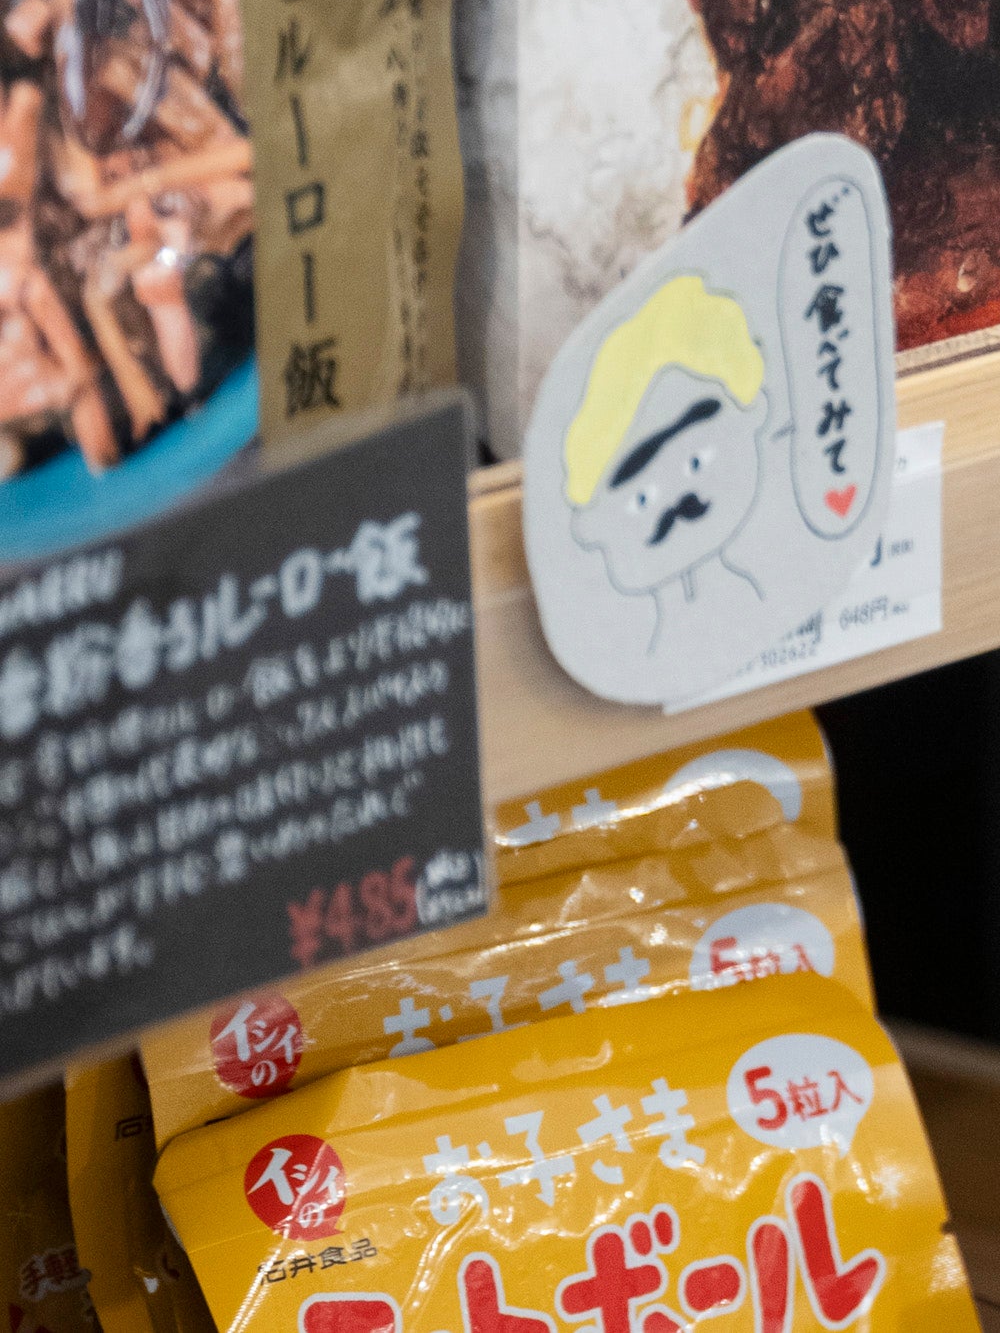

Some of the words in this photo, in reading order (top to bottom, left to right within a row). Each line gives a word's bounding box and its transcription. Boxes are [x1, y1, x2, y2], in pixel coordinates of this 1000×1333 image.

[422, 1078, 706, 1226] お子さま
[744, 1066, 864, 1132] 5粒入
[260, 1237, 378, 1283] 石井食品
[303, 1176, 878, 1333] トボール
